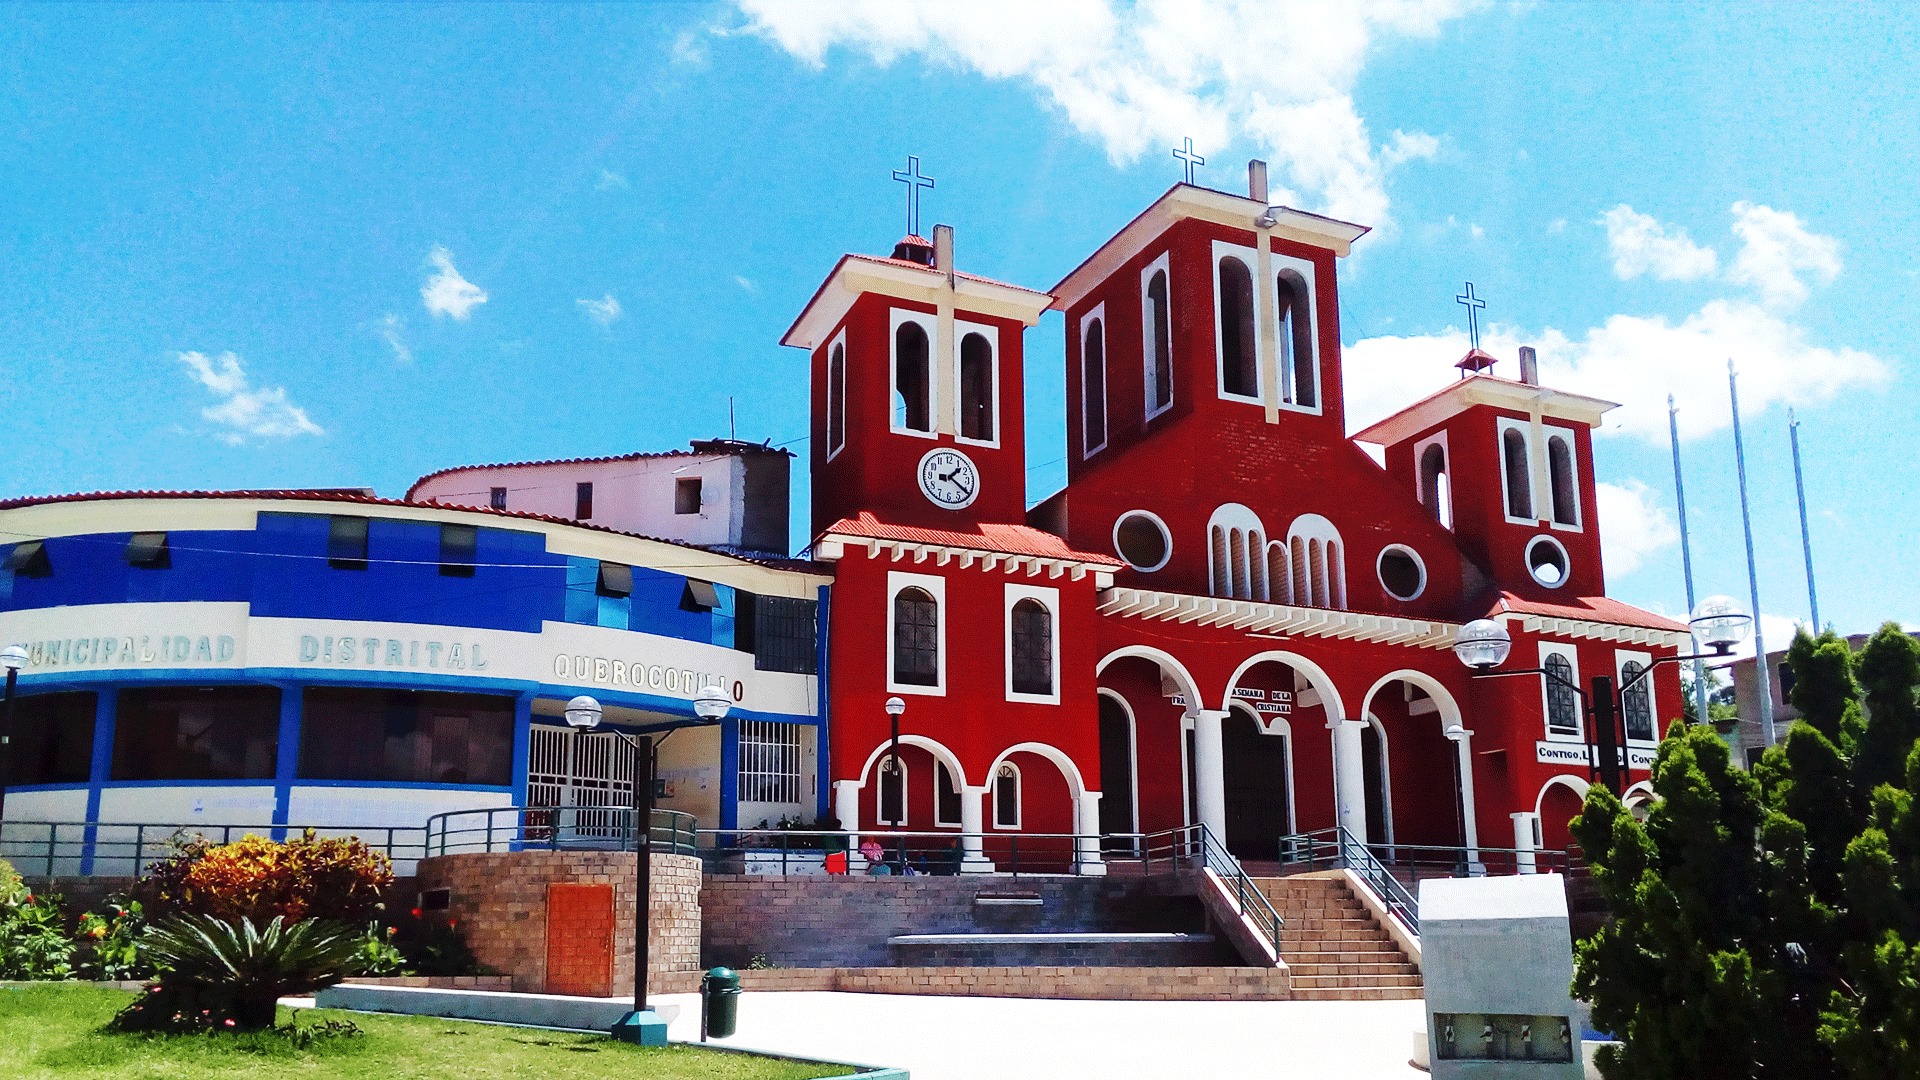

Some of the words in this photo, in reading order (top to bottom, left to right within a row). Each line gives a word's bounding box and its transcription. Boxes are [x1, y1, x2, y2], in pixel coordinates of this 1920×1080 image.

[12, 634, 236, 666] UNICIPALIDAD
[299, 634, 487, 671] DISTRITAL
[1257, 703, 1291, 713] CRISTIANA
